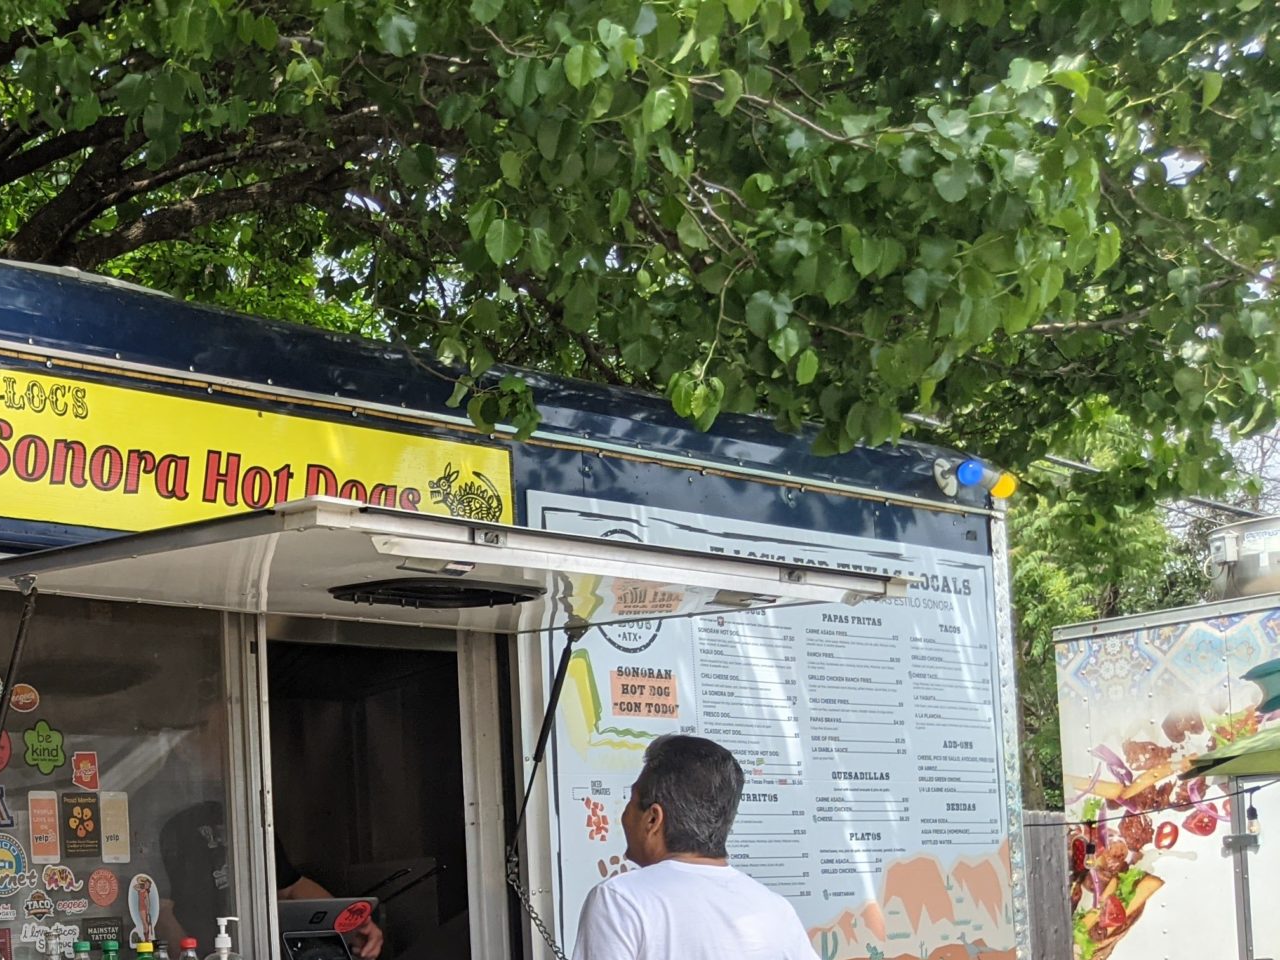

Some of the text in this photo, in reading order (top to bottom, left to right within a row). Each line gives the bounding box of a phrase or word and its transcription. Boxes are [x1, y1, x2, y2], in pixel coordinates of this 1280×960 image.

[202, 449, 294, 509] Hot
[922, 598, 955, 612] SONORA
[821, 613, 882, 626] PAPAS FRITAS
[938, 623, 961, 634] TACOS
[621, 631, 638, 642] ATX
[616, 665, 672, 680] SONORAN
[621, 683, 671, 697] HOT DOG
[36, 731, 52, 743] be
[943, 740, 973, 749] ADD-ONS
[31, 744, 59, 757] kind
[831, 771, 890, 781] QUESADILLAS
[591, 787, 611, 796] TOMATOES
[740, 793, 779, 802] URRITOS
[946, 803, 976, 811] BEBIDAS
[34, 834, 49, 843] yelp
[105, 833, 120, 842] yelp
[849, 832, 882, 841] PLATOS
[26, 900, 51, 909] TACO
[88, 927, 119, 935] MAINSTAY
[91, 933, 117, 941] TATTOO
